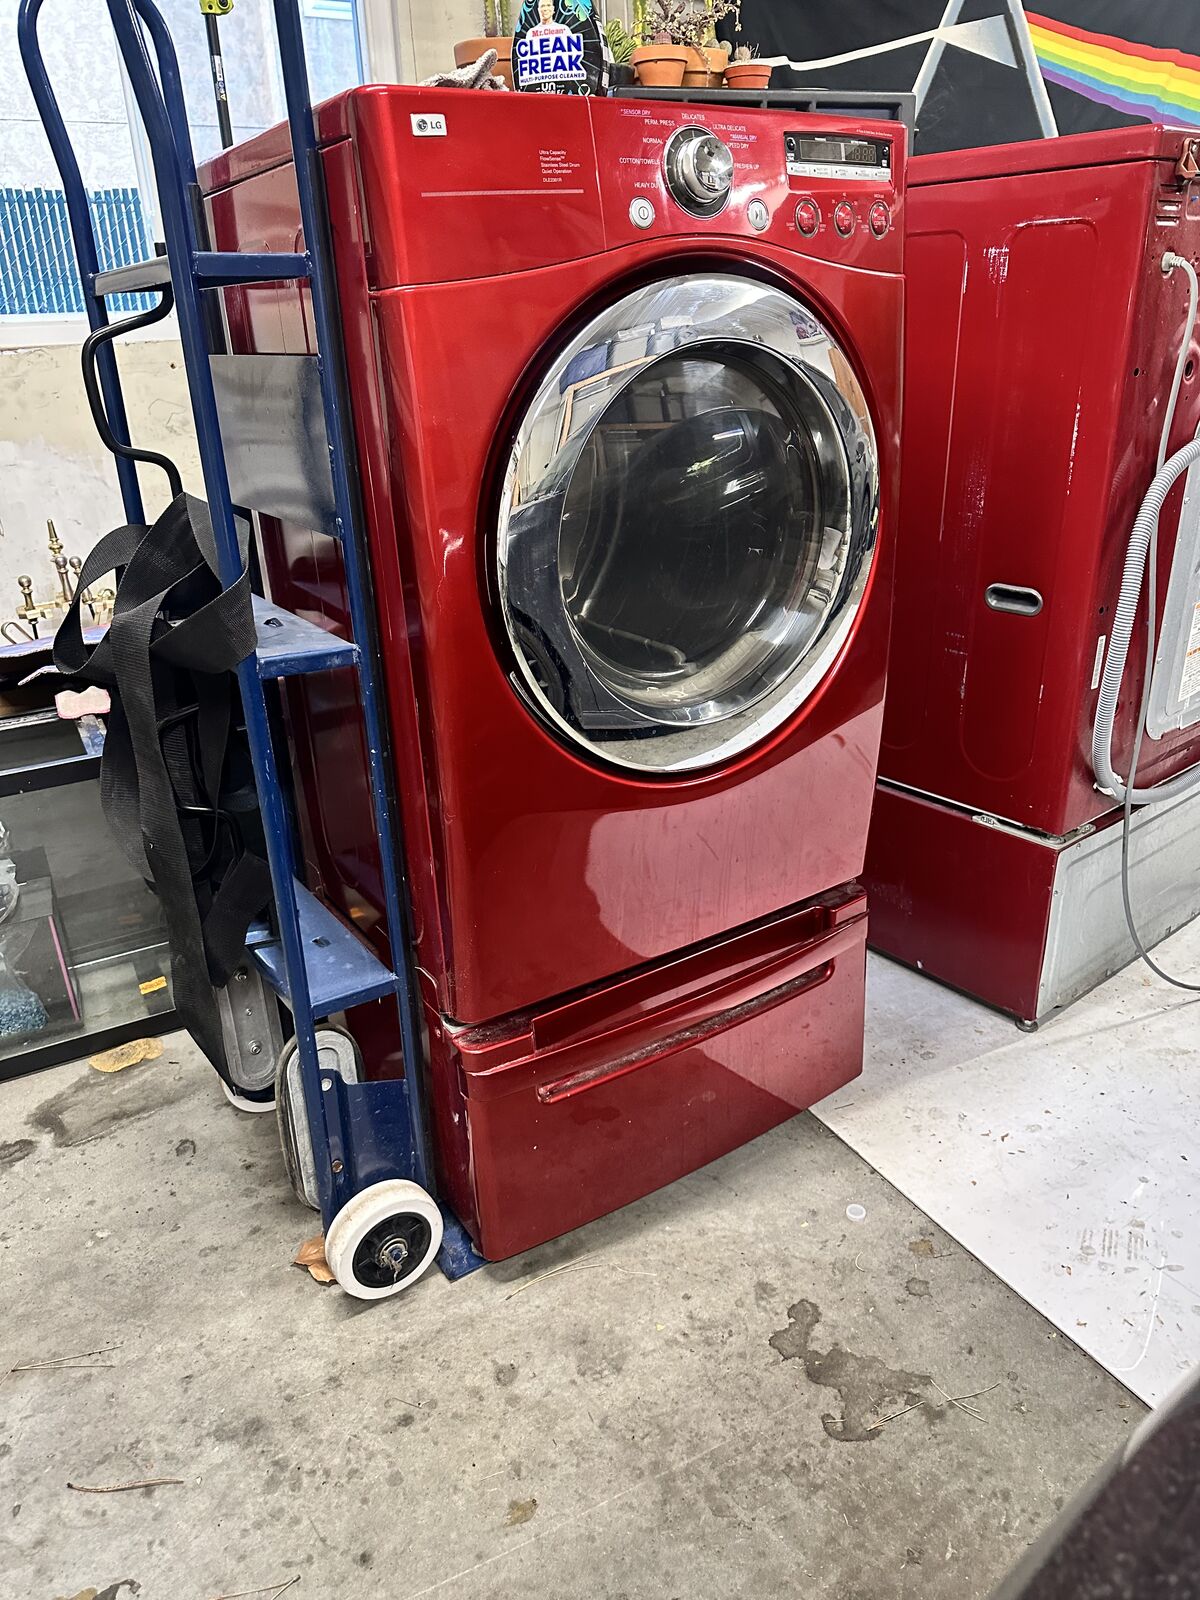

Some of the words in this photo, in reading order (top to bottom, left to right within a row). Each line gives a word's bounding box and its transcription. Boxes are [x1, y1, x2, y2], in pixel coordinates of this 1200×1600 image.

[517, 35, 582, 57] CLEAN
[519, 54, 583, 77] FREAK
[681, 113, 706, 121] DELICATES
[430, 121, 442, 129] LG
